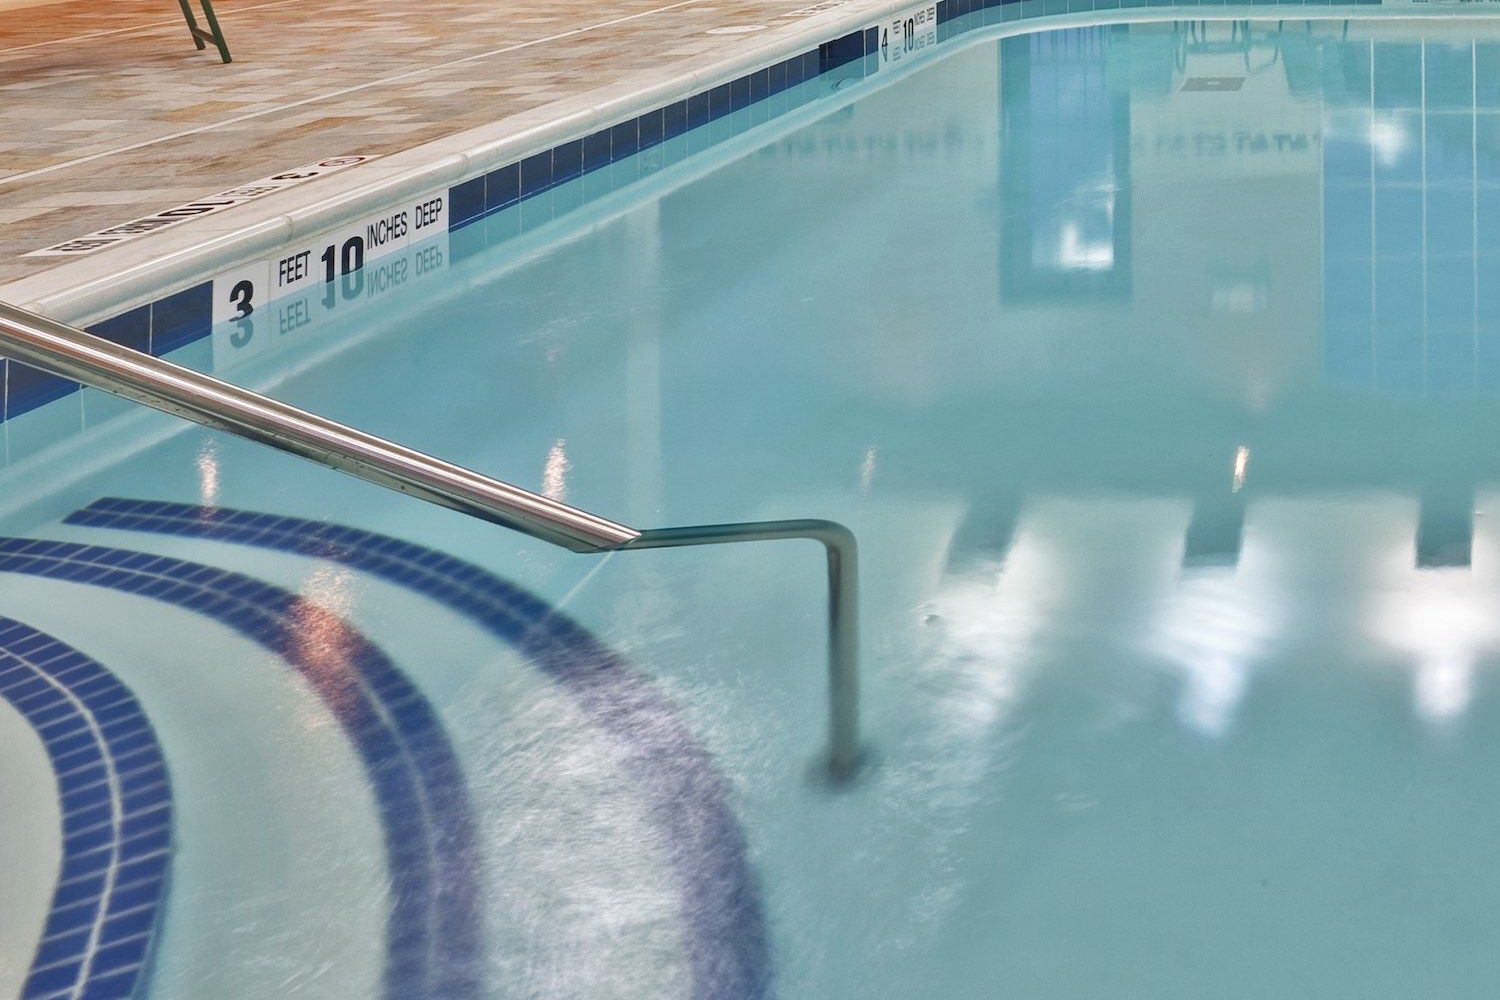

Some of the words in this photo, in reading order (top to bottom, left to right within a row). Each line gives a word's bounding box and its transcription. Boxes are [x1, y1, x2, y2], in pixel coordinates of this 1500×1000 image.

[882, 28, 888, 47] 4
[228, 280, 254, 322] 3
[279, 250, 311, 287] FEET
[321, 236, 364, 284] 10
[367, 211, 408, 250] INCHES
[415, 198, 443, 230] DEEP
